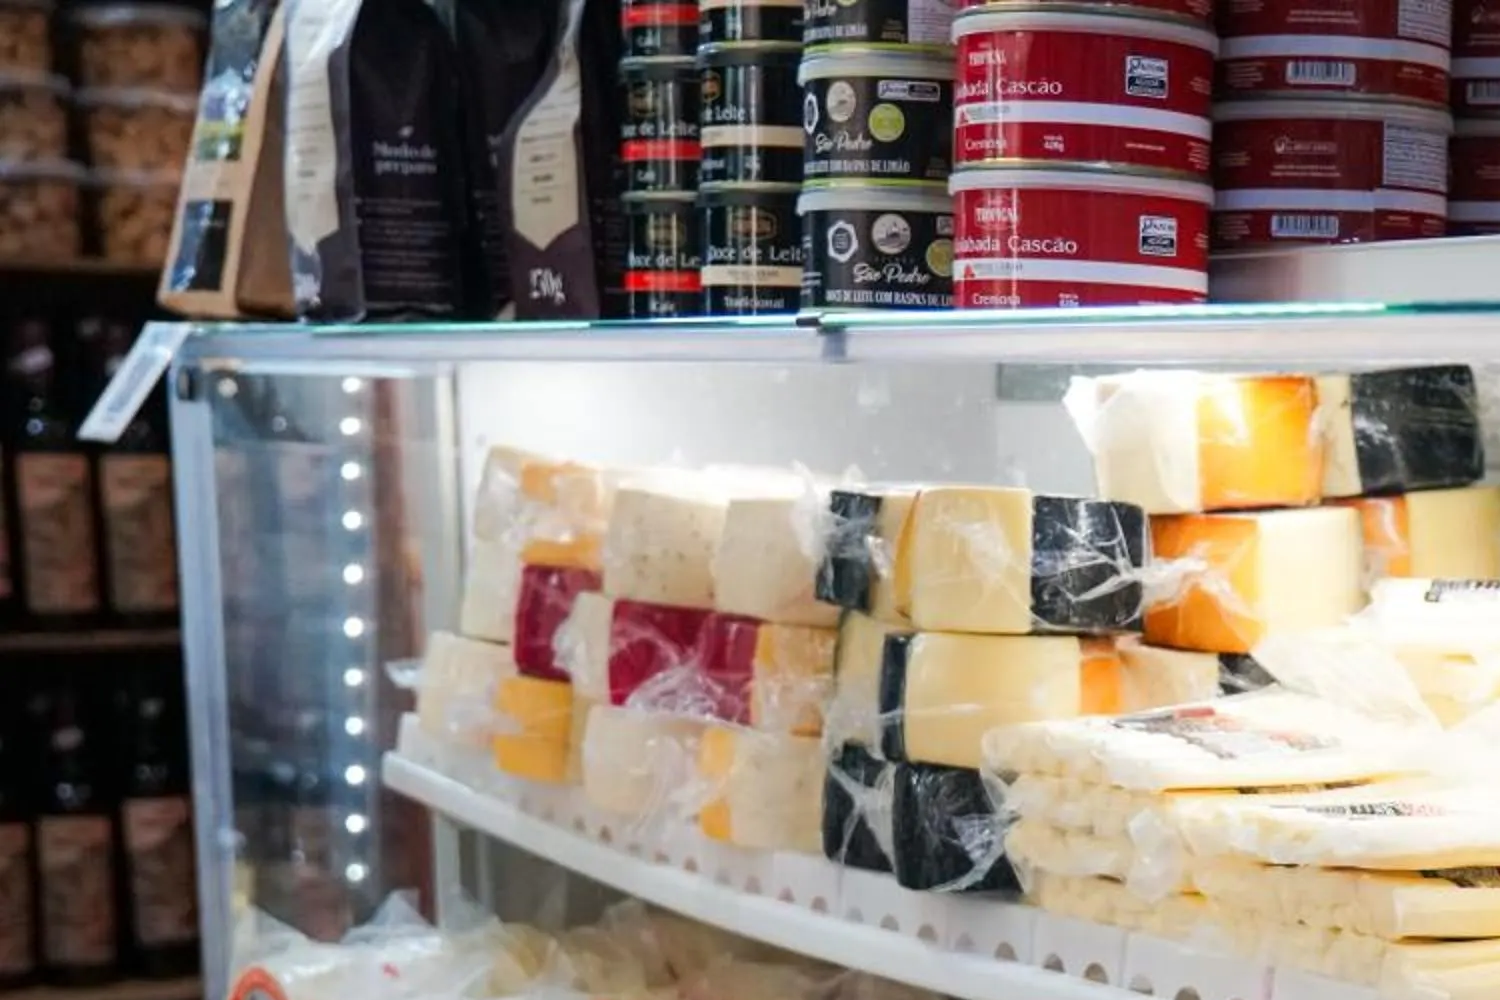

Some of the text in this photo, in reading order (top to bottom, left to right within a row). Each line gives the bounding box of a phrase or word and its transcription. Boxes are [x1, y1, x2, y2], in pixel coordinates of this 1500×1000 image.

[996, 78, 1063, 95] Cascão
[770, 244, 803, 261] Leit
[1007, 235, 1078, 254] Cascão
[883, 261, 931, 285] Pedro
